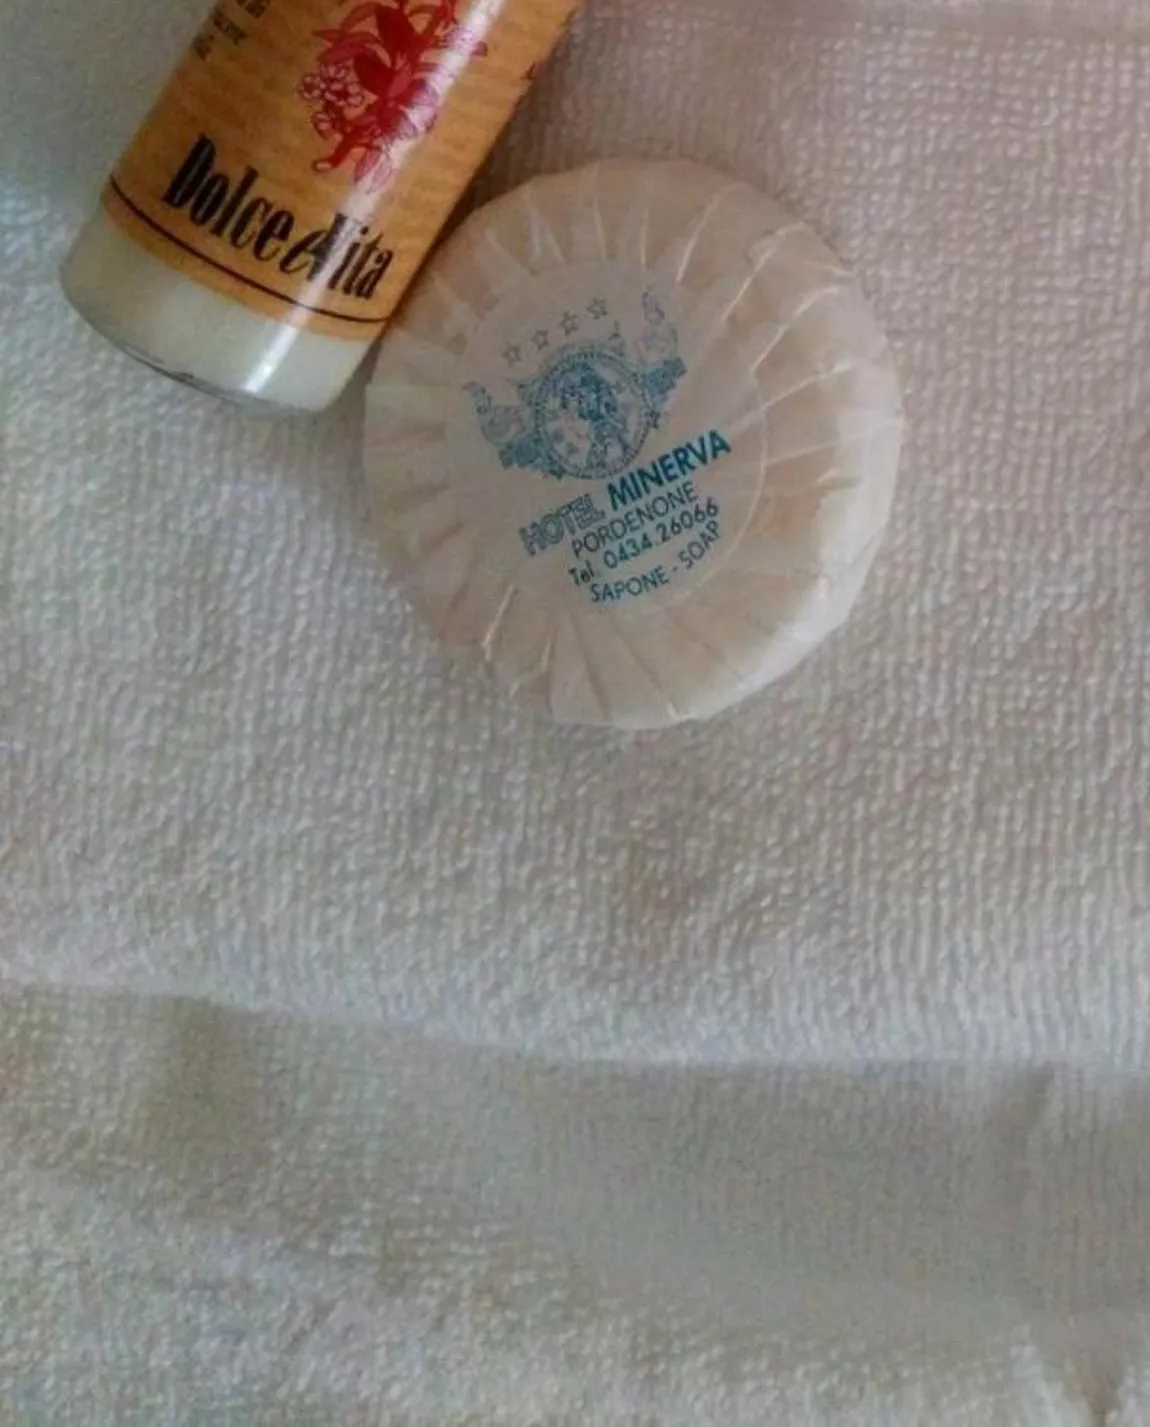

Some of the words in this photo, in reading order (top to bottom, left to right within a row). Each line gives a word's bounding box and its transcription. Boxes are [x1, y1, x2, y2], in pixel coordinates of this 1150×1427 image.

[519, 493, 606, 557] HOTEL
[607, 429, 732, 512] MINERVA
[571, 481, 699, 559] PORDENONE
[589, 566, 669, 603] SAPONE
[678, 520, 721, 570] SOAP
